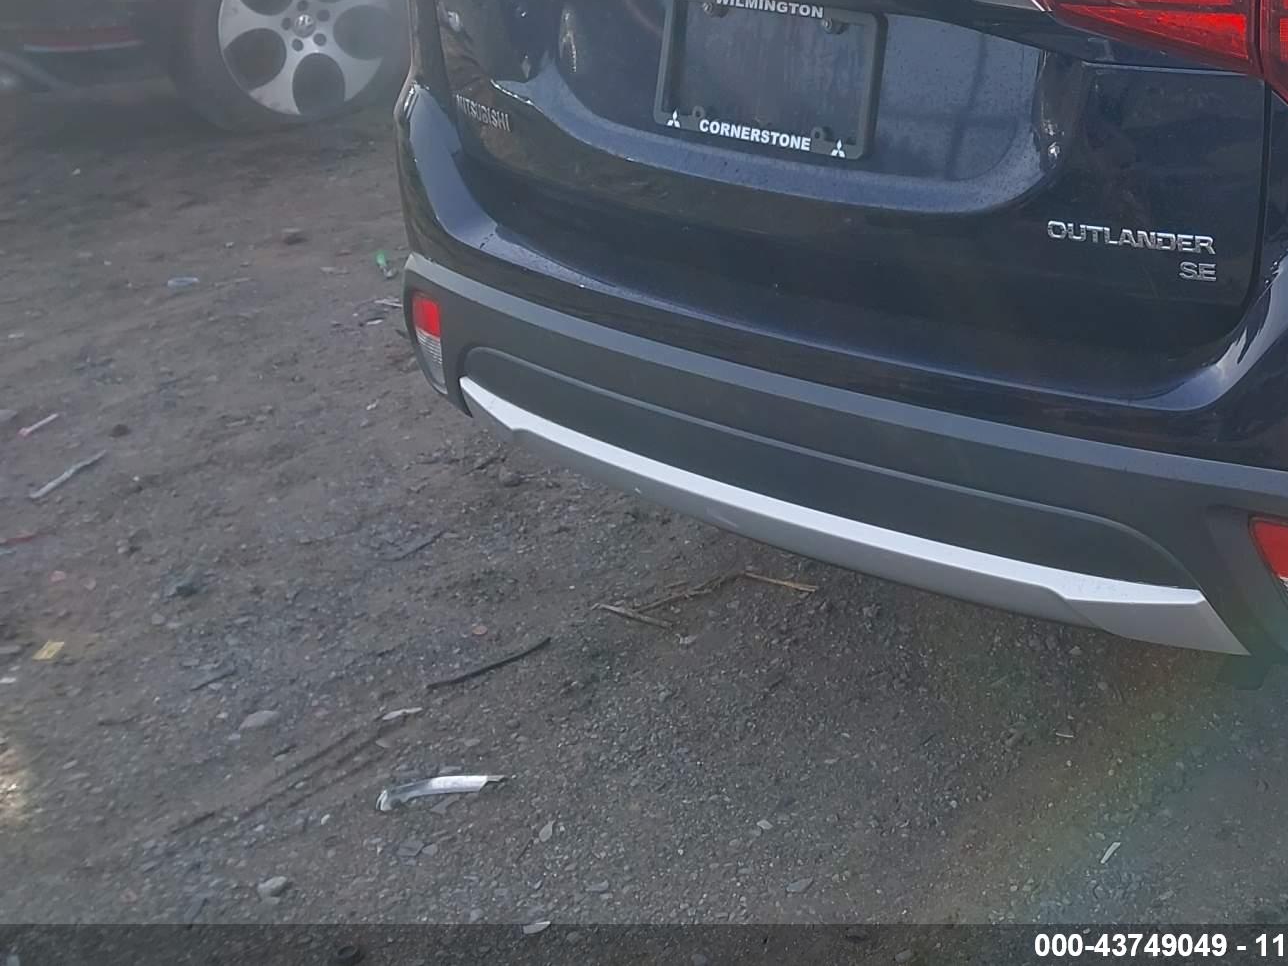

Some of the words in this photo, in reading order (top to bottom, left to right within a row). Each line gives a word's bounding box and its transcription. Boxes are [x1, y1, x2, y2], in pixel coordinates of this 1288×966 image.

[699, 119, 811, 152] CORNERSTONE
[1047, 220, 1216, 255] OUTLANDER
[1179, 261, 1217, 282] SE
